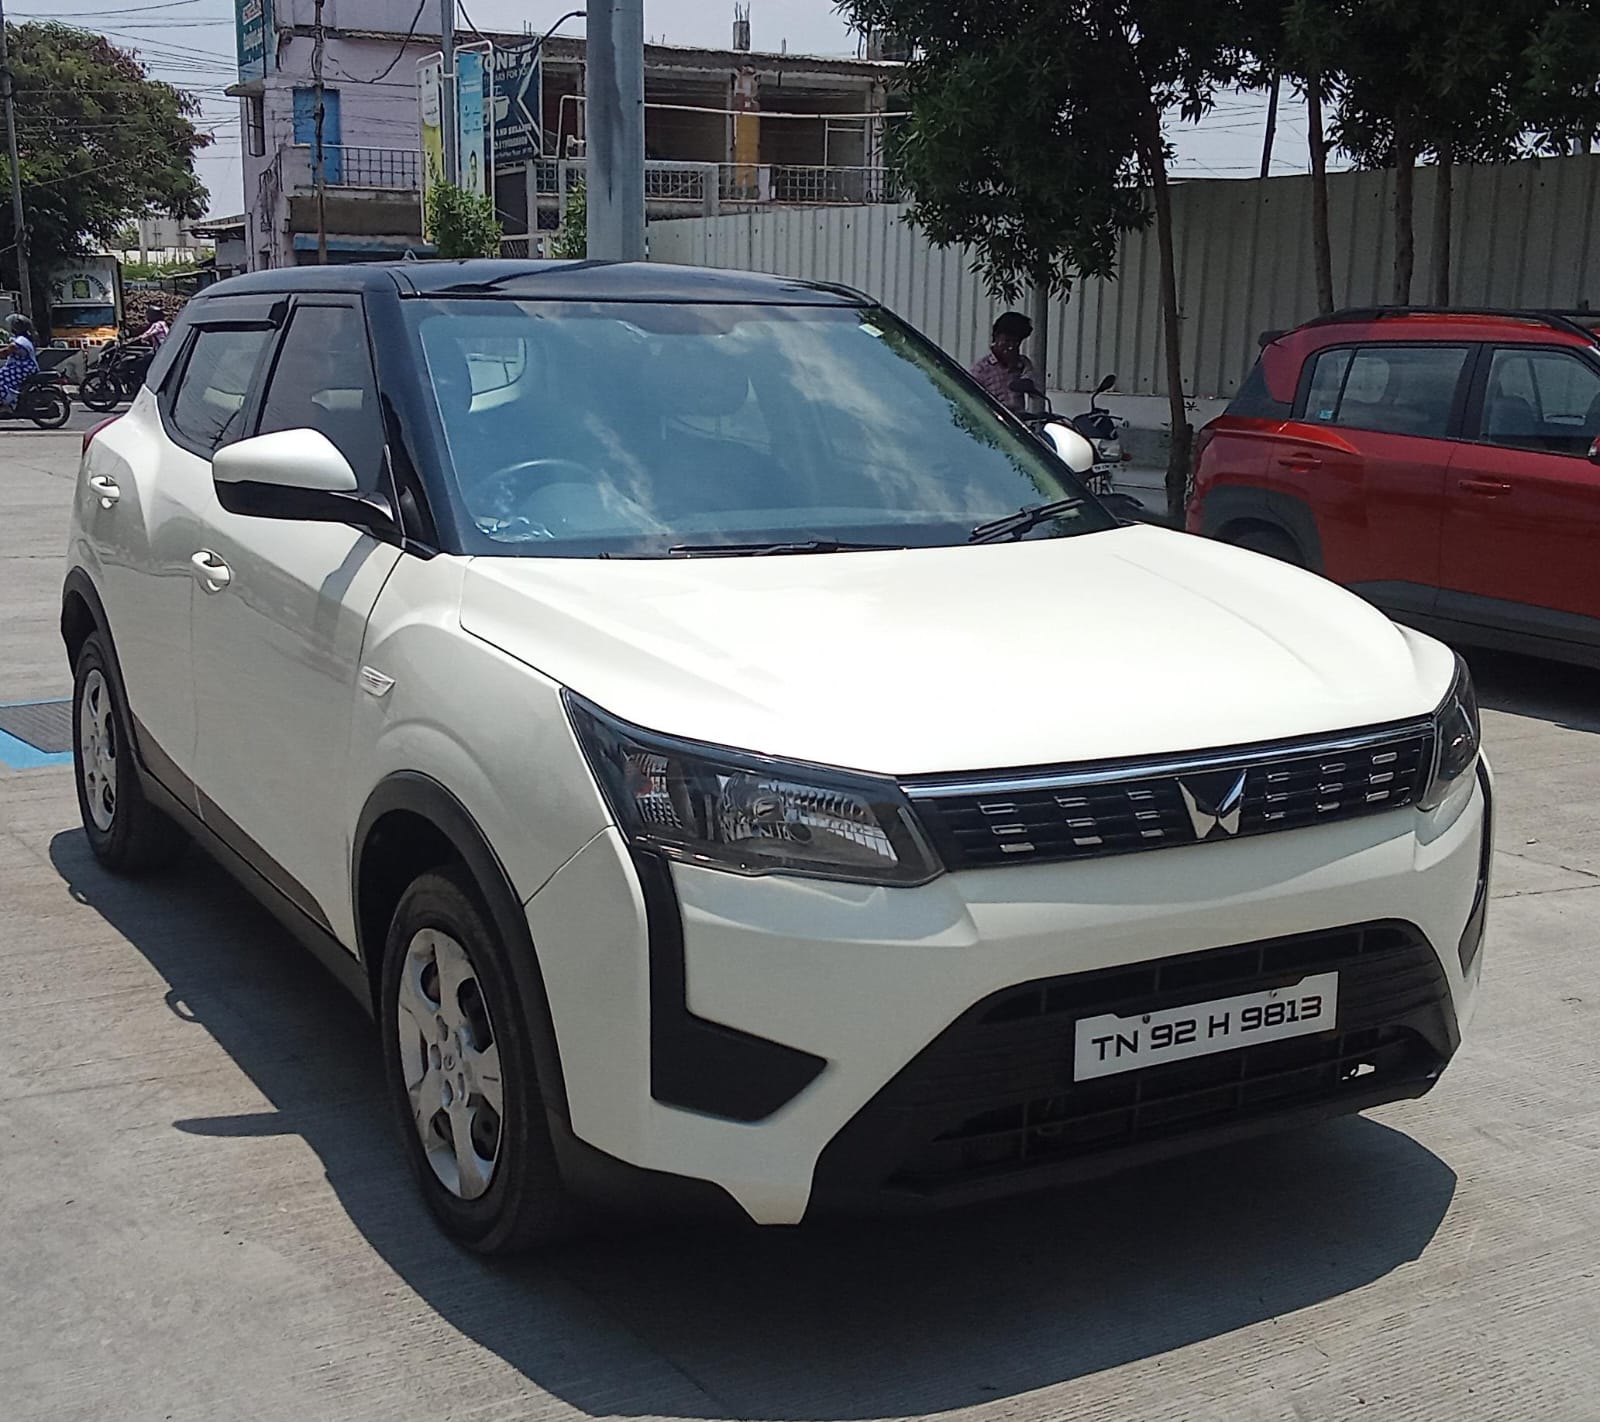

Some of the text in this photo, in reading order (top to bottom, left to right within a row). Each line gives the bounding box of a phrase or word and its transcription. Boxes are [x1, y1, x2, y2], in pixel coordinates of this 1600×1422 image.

[1091, 995, 1322, 1061] TN 92 H 9813
